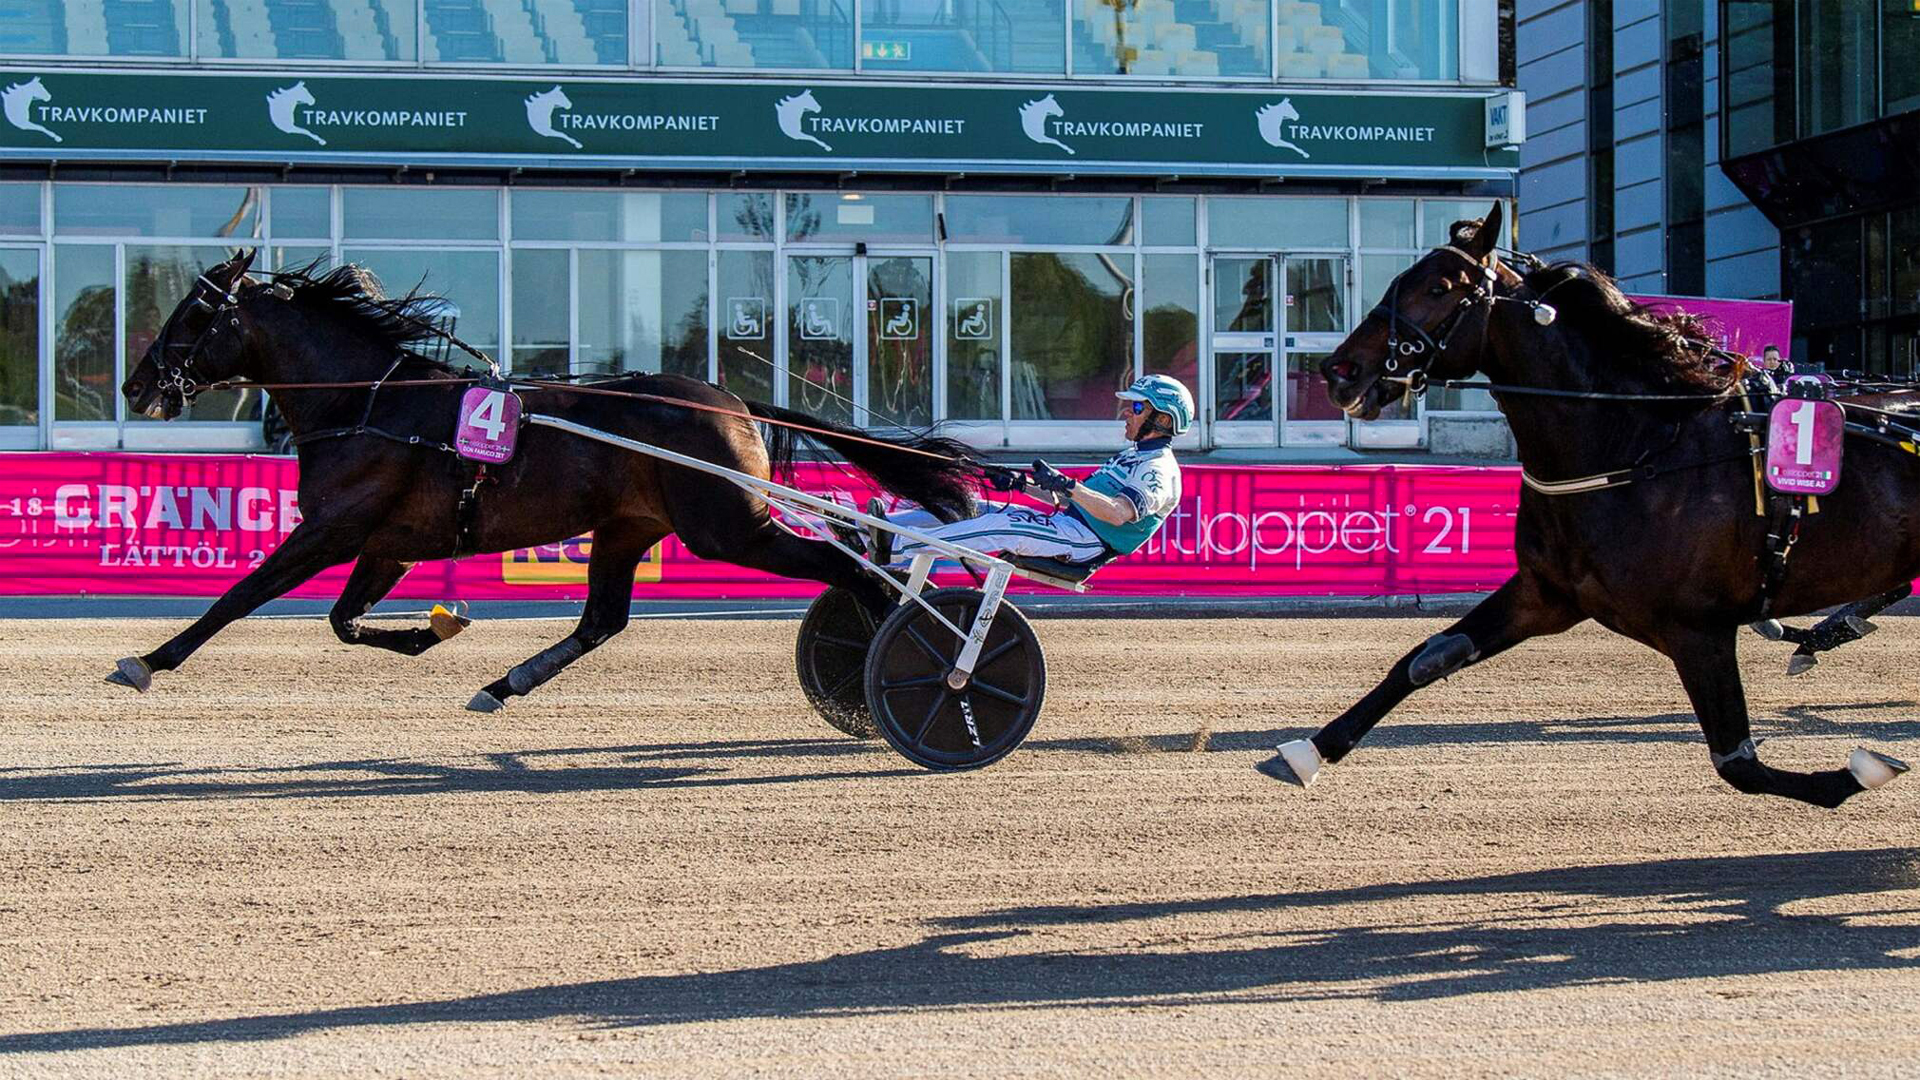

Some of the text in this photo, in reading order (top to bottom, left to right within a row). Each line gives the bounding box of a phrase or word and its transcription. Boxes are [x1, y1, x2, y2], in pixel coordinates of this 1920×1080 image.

[38, 106, 208, 126] TRAVKOMPANIET
[303, 110, 467, 128] TRAVKOMPANIET
[560, 113, 720, 131] TRAVKOMPANIET
[809, 117, 965, 135] TRAVKOMPANIET
[1052, 120, 1203, 138] TRAVKOMPANIET
[1289, 123, 1435, 142] TRAVKOMPANIET
[468, 390, 506, 441] 4
[1791, 401, 1815, 465] 1
[1423, 506, 1470, 554] 21
[100, 540, 236, 568] LÄTTÖL
